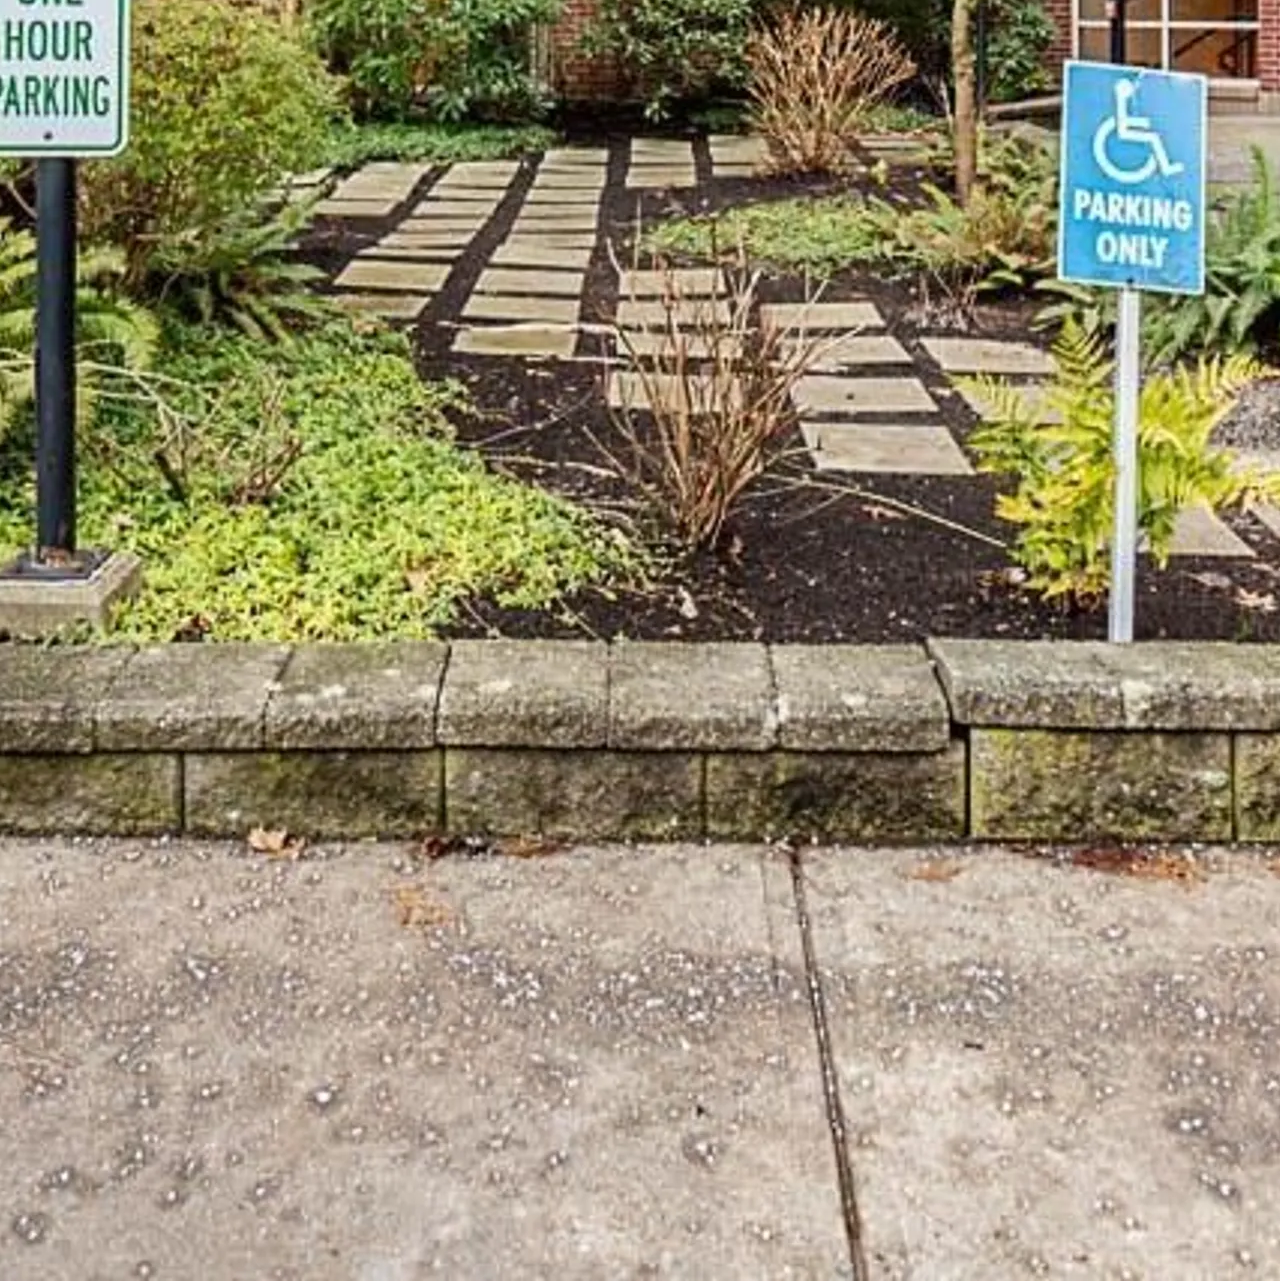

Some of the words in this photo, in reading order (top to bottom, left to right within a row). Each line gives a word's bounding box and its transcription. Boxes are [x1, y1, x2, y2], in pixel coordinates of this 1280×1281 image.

[4, 20, 93, 62] HOUR
[1074, 189, 1194, 232] PARKING
[1095, 231, 1169, 268] ONLY
